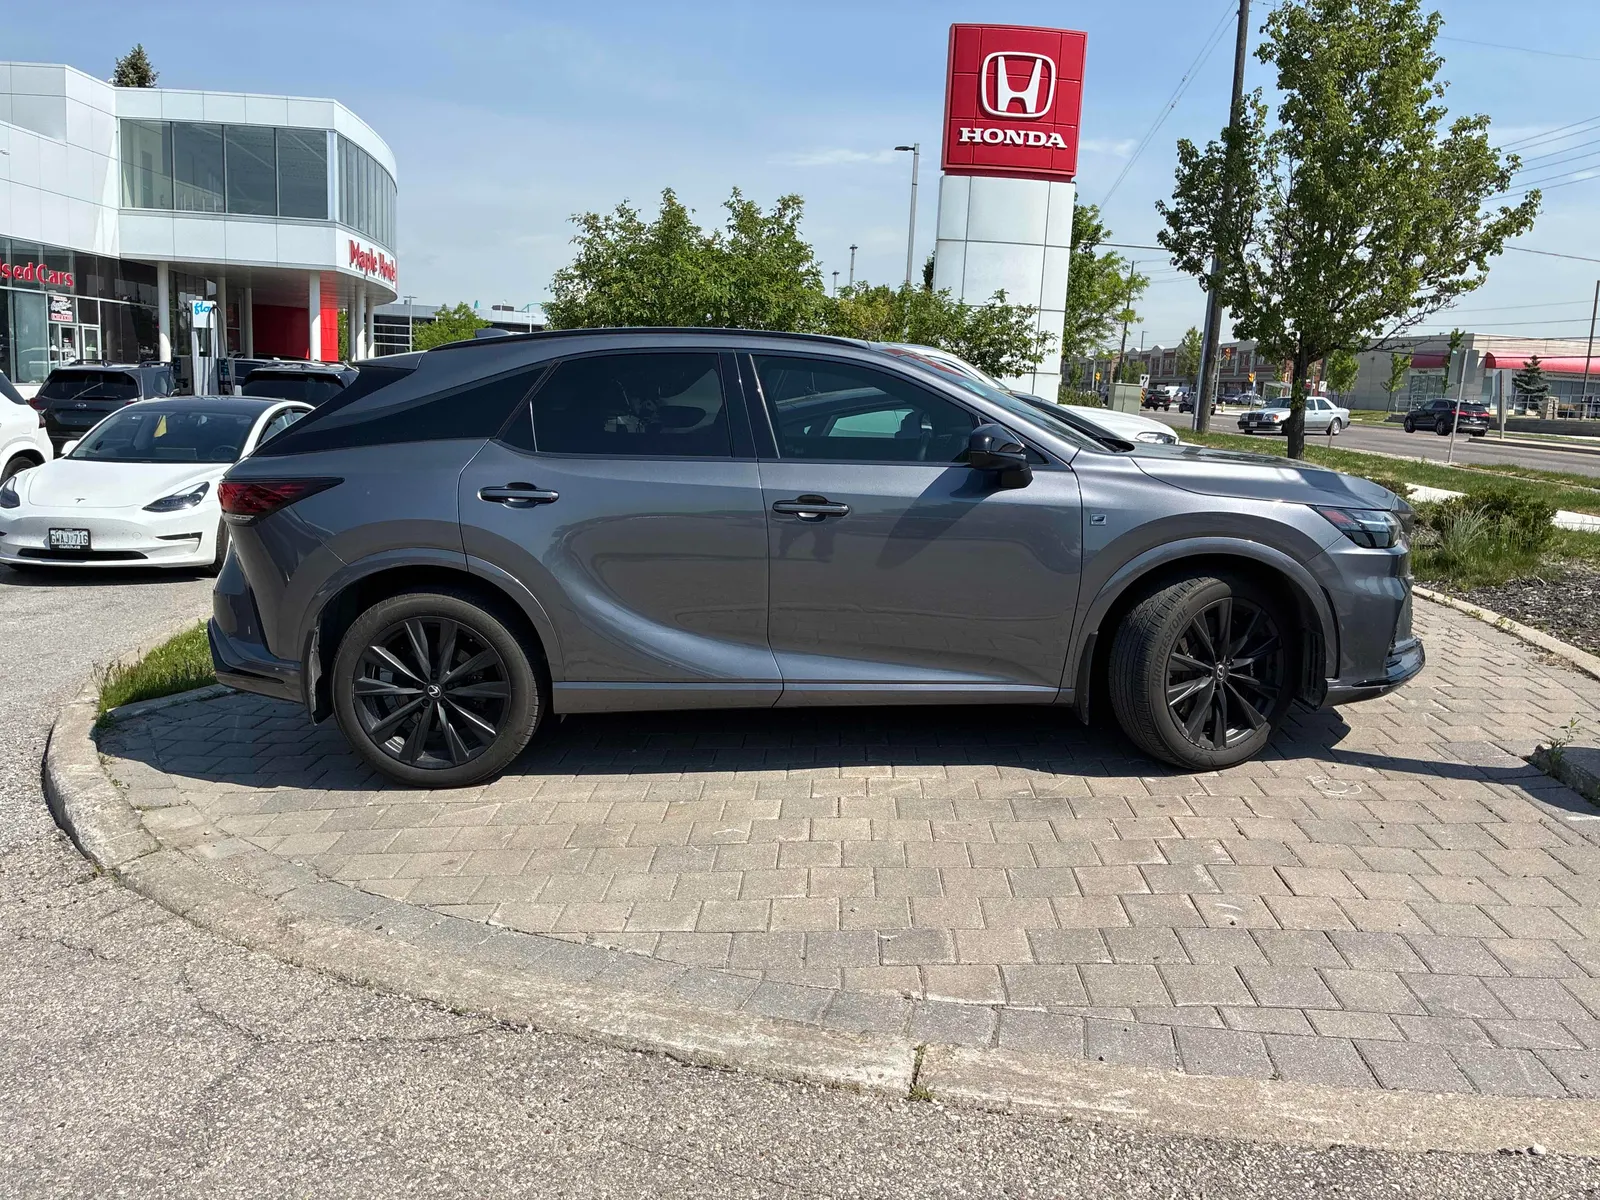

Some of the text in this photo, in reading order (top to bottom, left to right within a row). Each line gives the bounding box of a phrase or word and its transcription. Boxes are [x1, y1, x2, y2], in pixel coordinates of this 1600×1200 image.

[958, 127, 1068, 149] HONDA
[349, 239, 377, 276] Maple
[0, 259, 74, 287] sed Cars
[194, 301, 211, 315] flo
